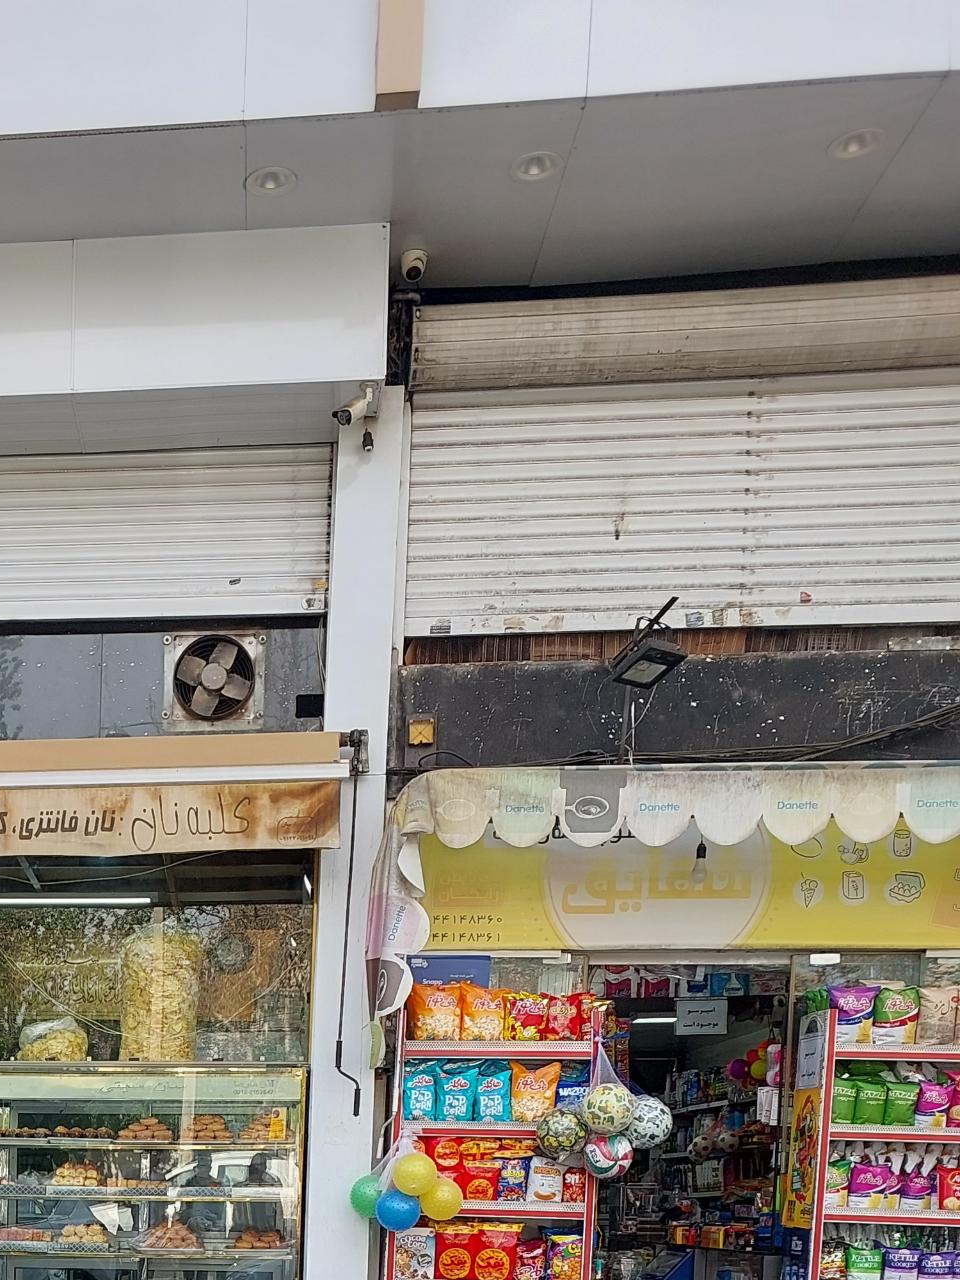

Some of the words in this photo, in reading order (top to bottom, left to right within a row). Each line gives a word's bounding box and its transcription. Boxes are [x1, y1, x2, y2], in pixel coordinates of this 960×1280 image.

[505, 803, 545, 813] Danette
[640, 802, 680, 812] Danette
[777, 800, 818, 811] Danette
[917, 799, 959, 809] Danette
[187, 792, 250, 841] کلبه
[84, 810, 116, 837] نان
[387, 905, 407, 942] Danette
[433, 914, 503, 925] ۴۴۱۴۸۳۶۰
[432, 932, 501, 943] ۴۴۱۴۸۳۶۱
[696, 1021, 719, 1029] موجود
